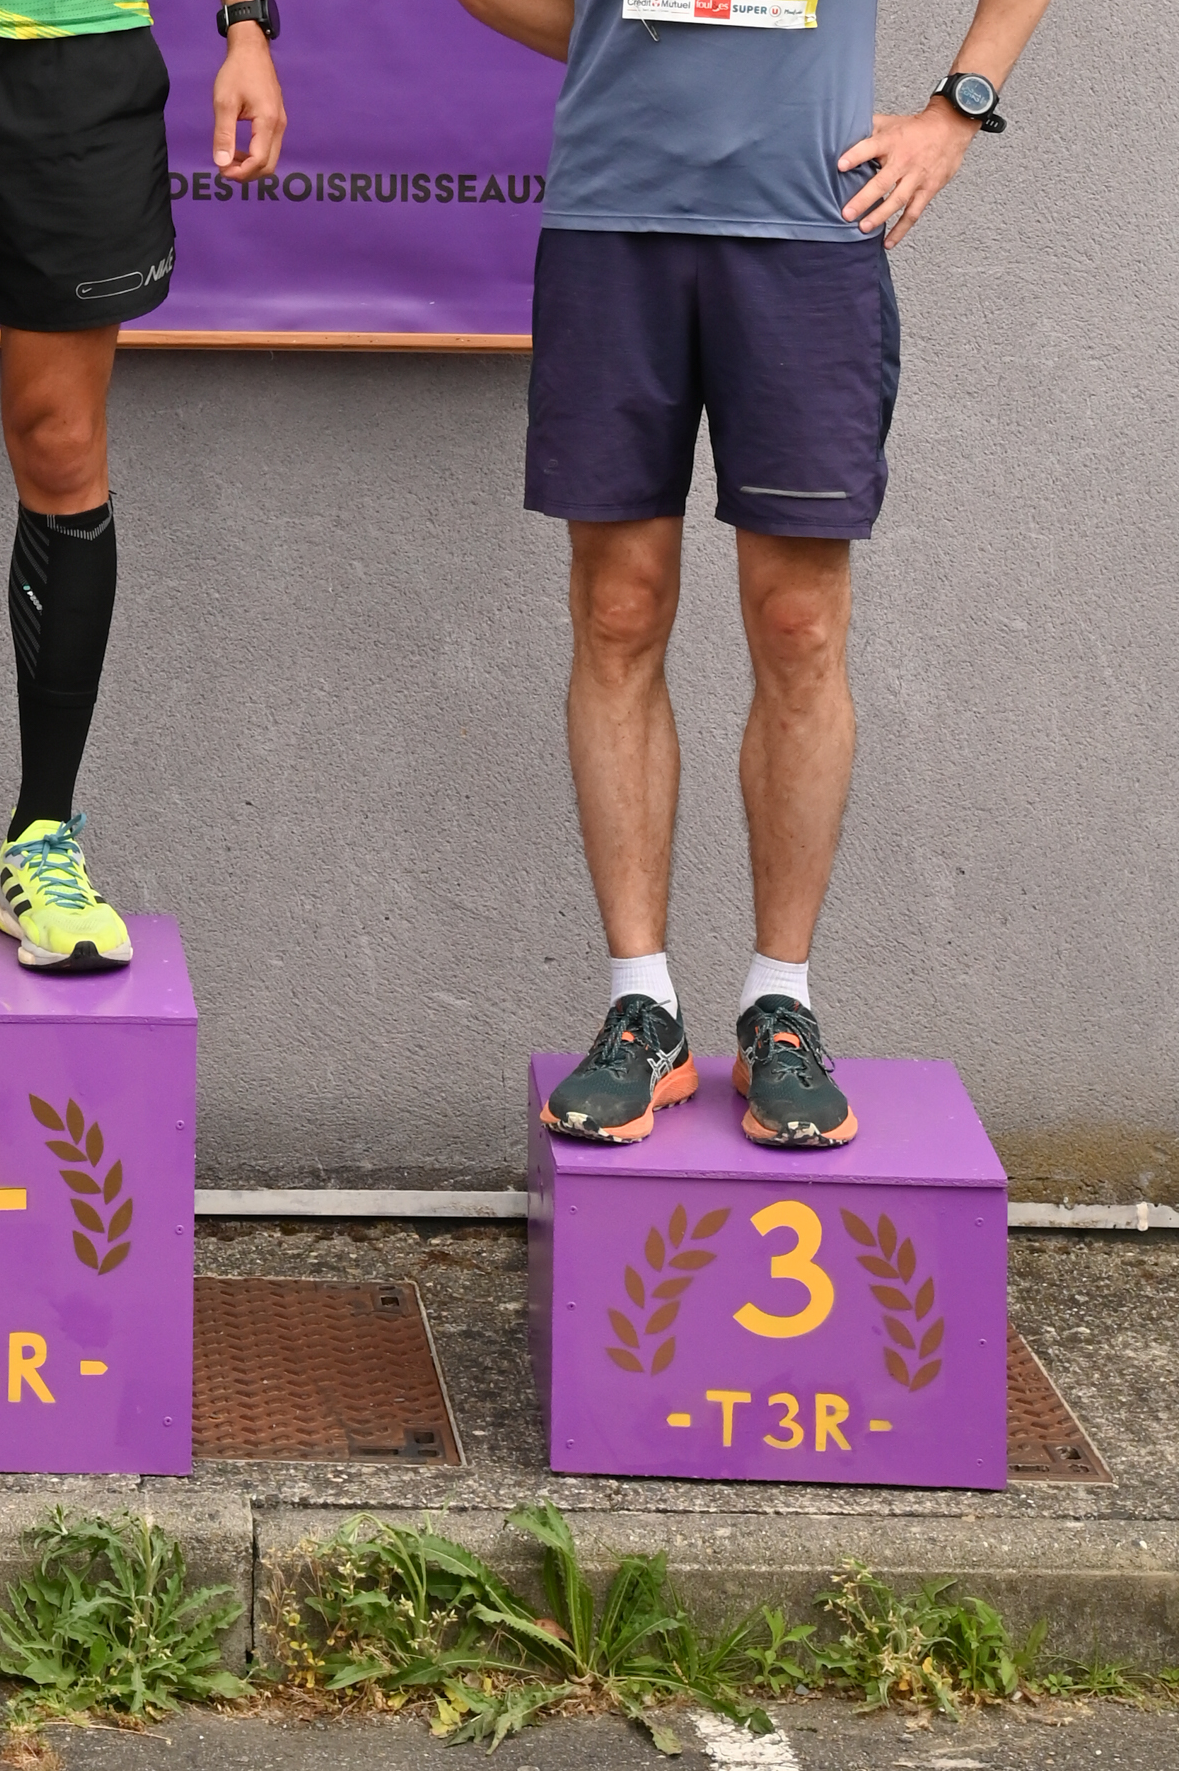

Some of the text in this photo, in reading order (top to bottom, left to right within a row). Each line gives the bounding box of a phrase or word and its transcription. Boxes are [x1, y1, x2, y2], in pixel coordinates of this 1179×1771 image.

[662, 0, 691, 9] Mutuel
[732, 4, 767, 14] SUPER
[733, 1200, 835, 1338] 3
